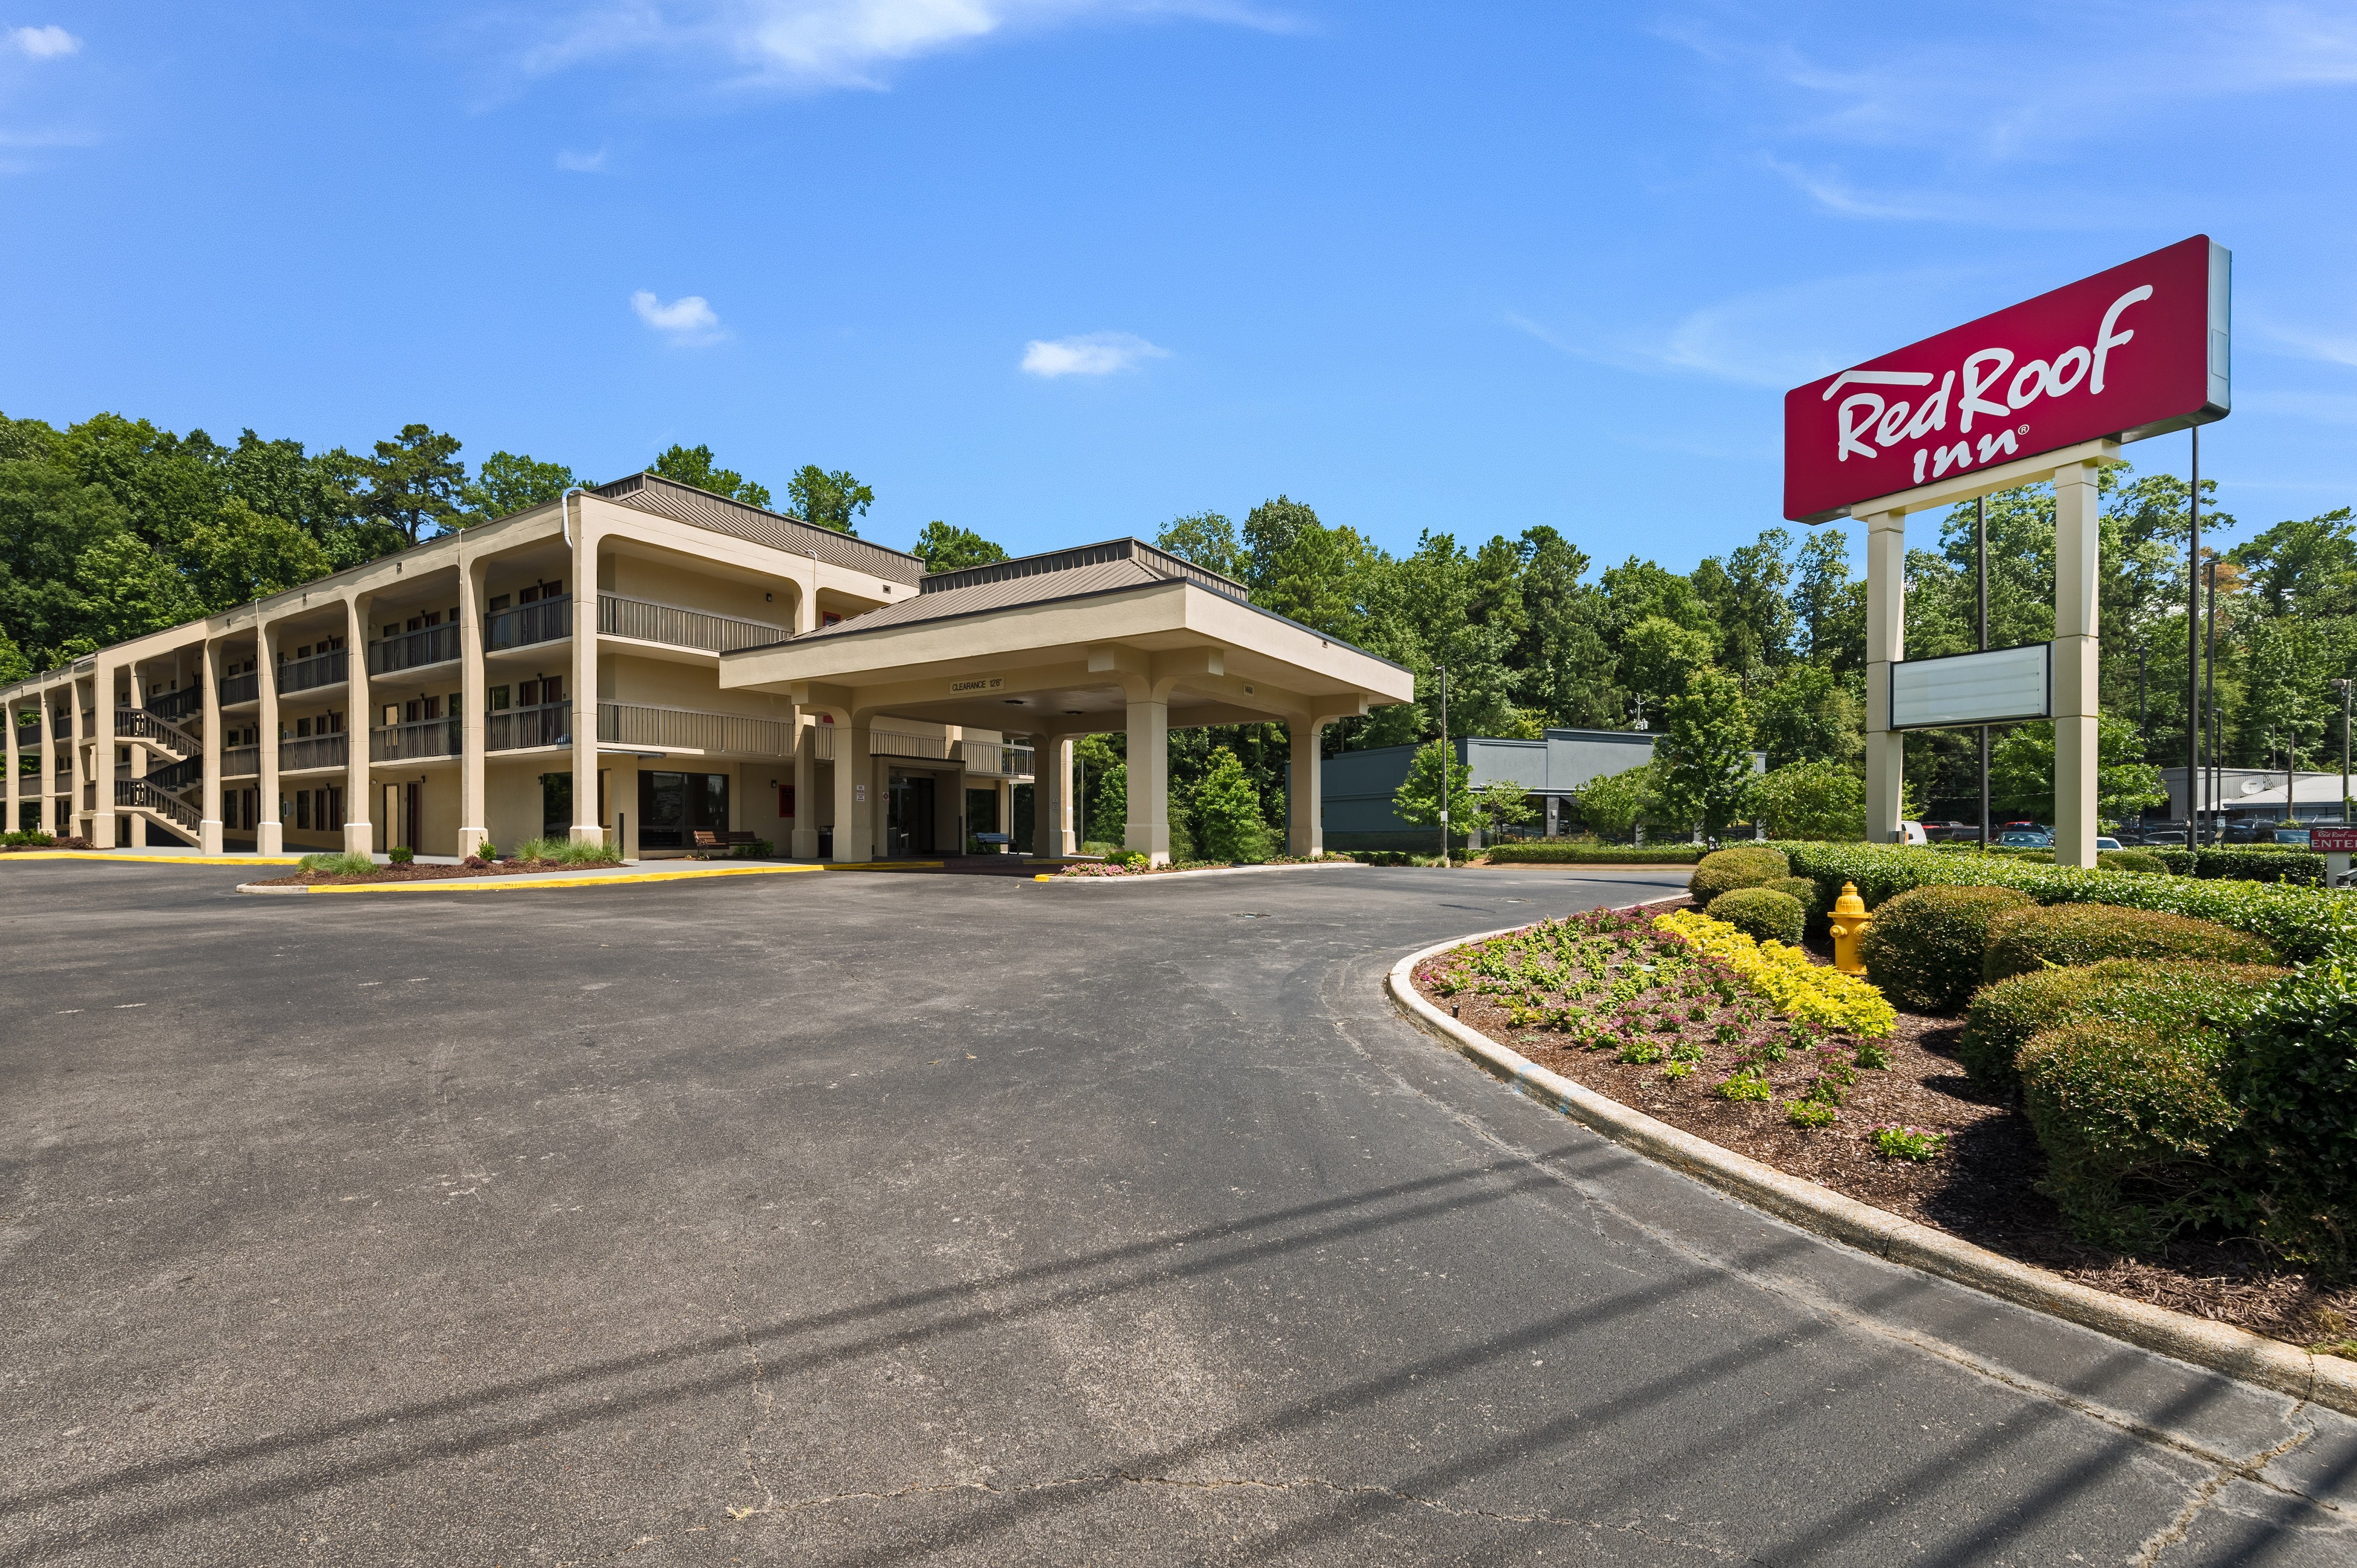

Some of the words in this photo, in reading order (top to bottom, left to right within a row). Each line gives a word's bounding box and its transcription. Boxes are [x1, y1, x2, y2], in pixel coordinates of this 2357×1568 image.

[1838, 370, 1956, 462] Red
[1958, 284, 2153, 434] Roof
[952, 680, 986, 691] CLEARANCE
[2311, 840, 2357, 848] ENTE
